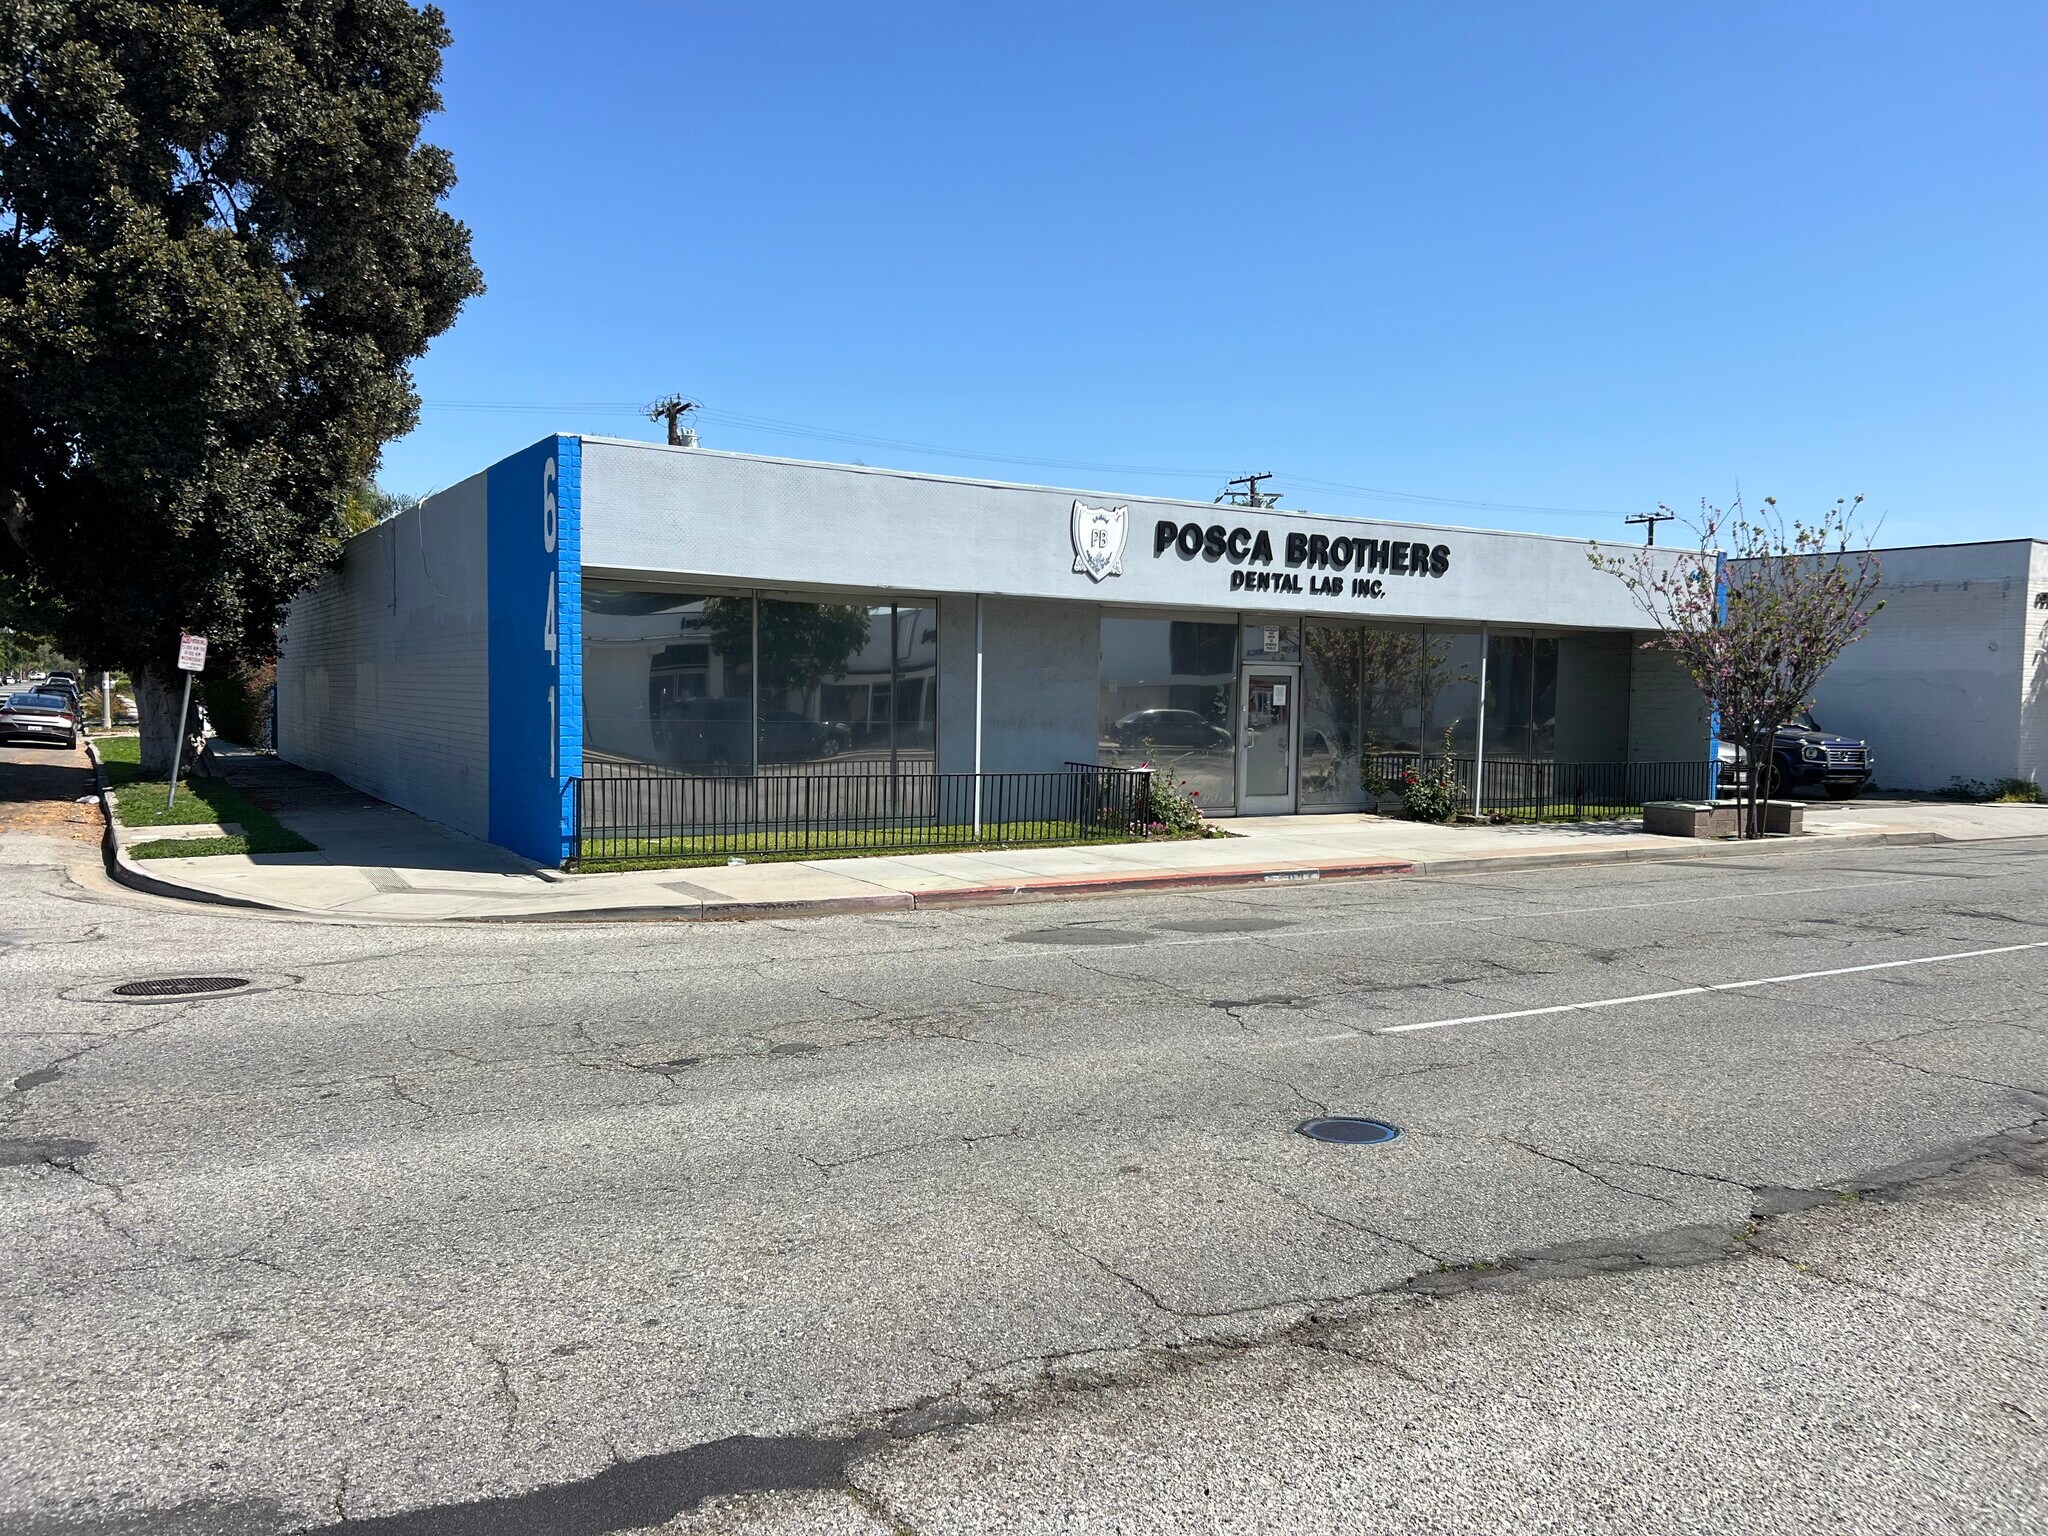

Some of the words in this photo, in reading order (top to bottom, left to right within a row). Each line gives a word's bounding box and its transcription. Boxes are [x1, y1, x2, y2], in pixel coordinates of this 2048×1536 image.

[1091, 528, 1108, 548] PB
[1154, 520, 1273, 566] POSCA
[1286, 532, 1451, 578] BROTHERS
[1230, 570, 1303, 594] DENTAL
[1309, 575, 1344, 596] LAB
[1351, 578, 1386, 599] INC.
[543, 456, 557, 779] 641
